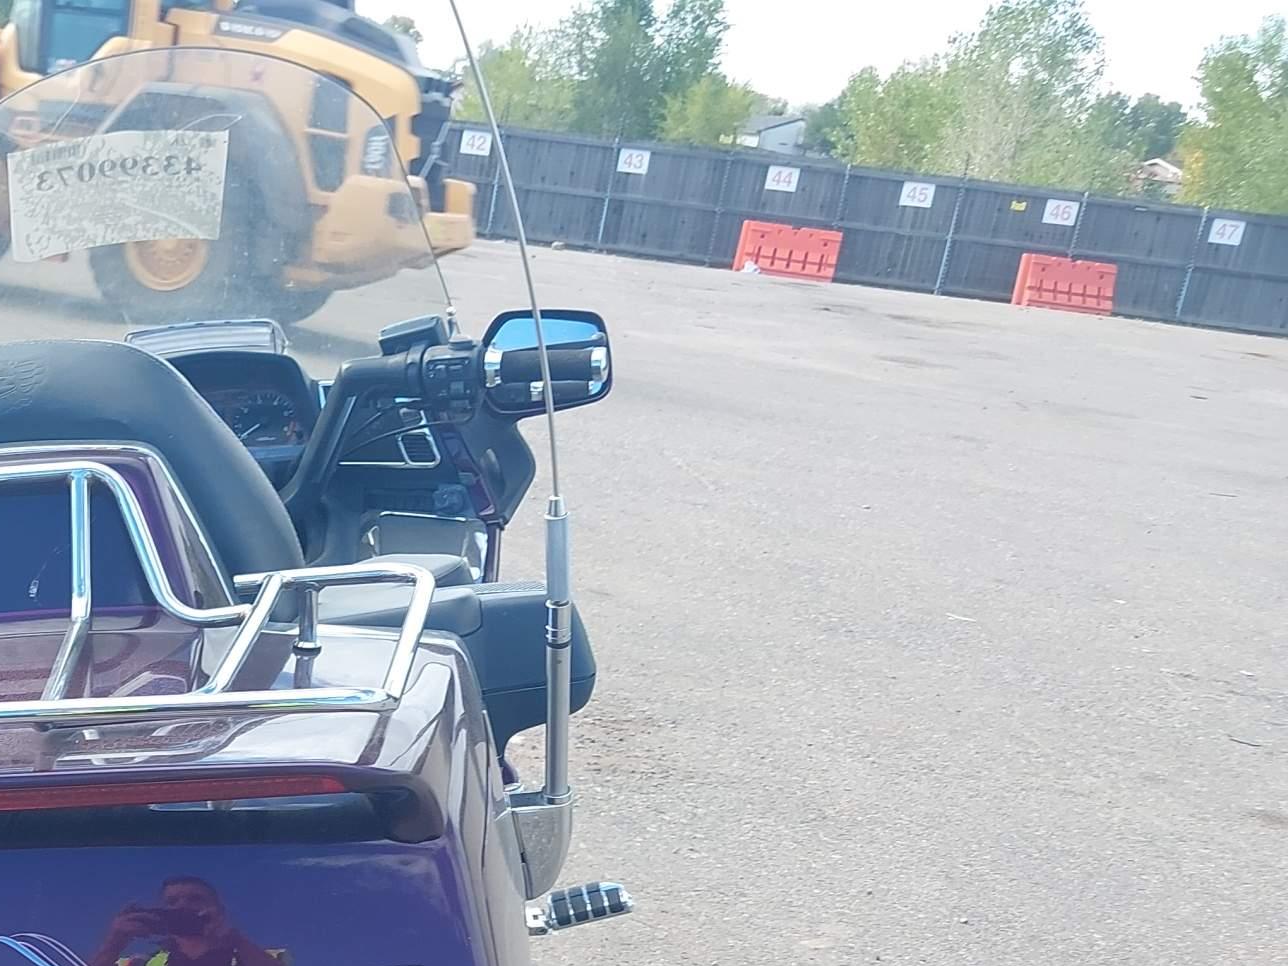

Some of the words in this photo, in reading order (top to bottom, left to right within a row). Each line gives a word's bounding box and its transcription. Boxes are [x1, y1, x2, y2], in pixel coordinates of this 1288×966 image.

[466, 134, 486, 151] 42
[623, 153, 644, 170] 43
[772, 170, 793, 187] 44
[907, 186, 928, 204] 45
[1049, 204, 1072, 221] 46
[1215, 223, 1240, 241] 47
